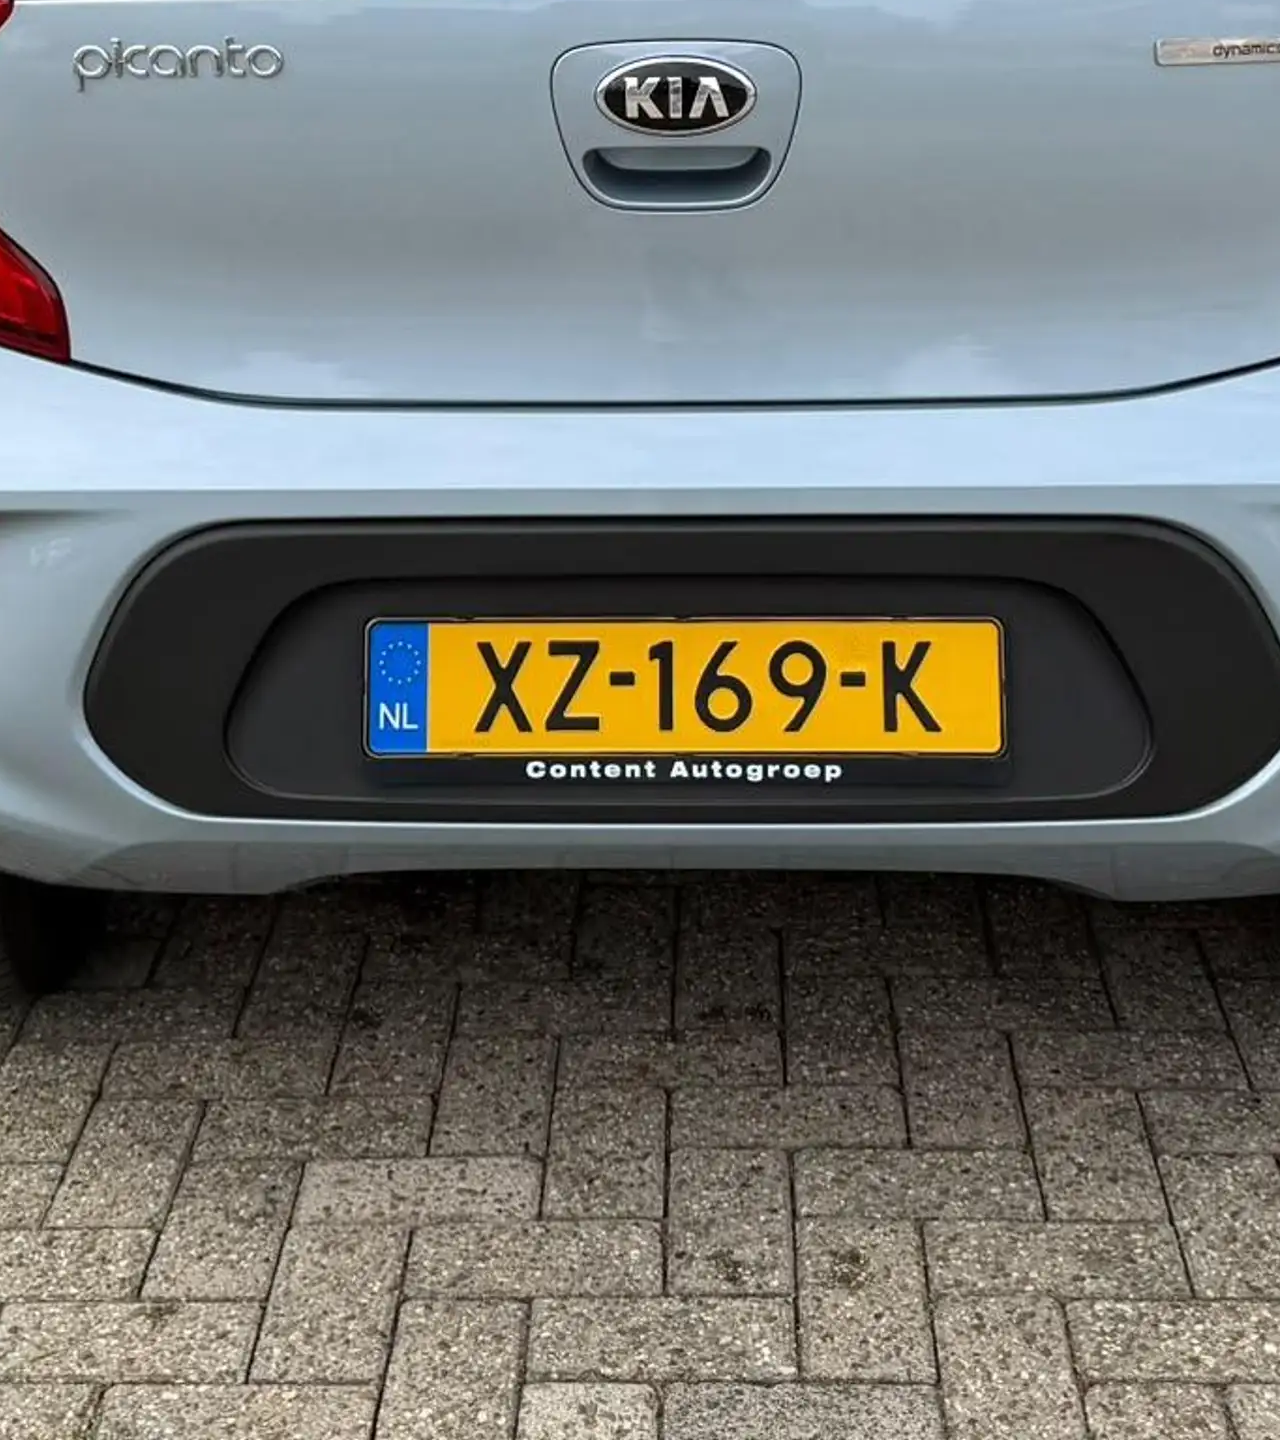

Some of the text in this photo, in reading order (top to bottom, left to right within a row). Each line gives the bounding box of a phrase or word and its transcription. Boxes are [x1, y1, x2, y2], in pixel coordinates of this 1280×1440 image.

[73, 36, 284, 92] picanto
[624, 76, 730, 119] KIA
[474, 640, 942, 733] XZ-169-K
[379, 702, 419, 730] NL
[526, 760, 843, 782] Content Autogroep
